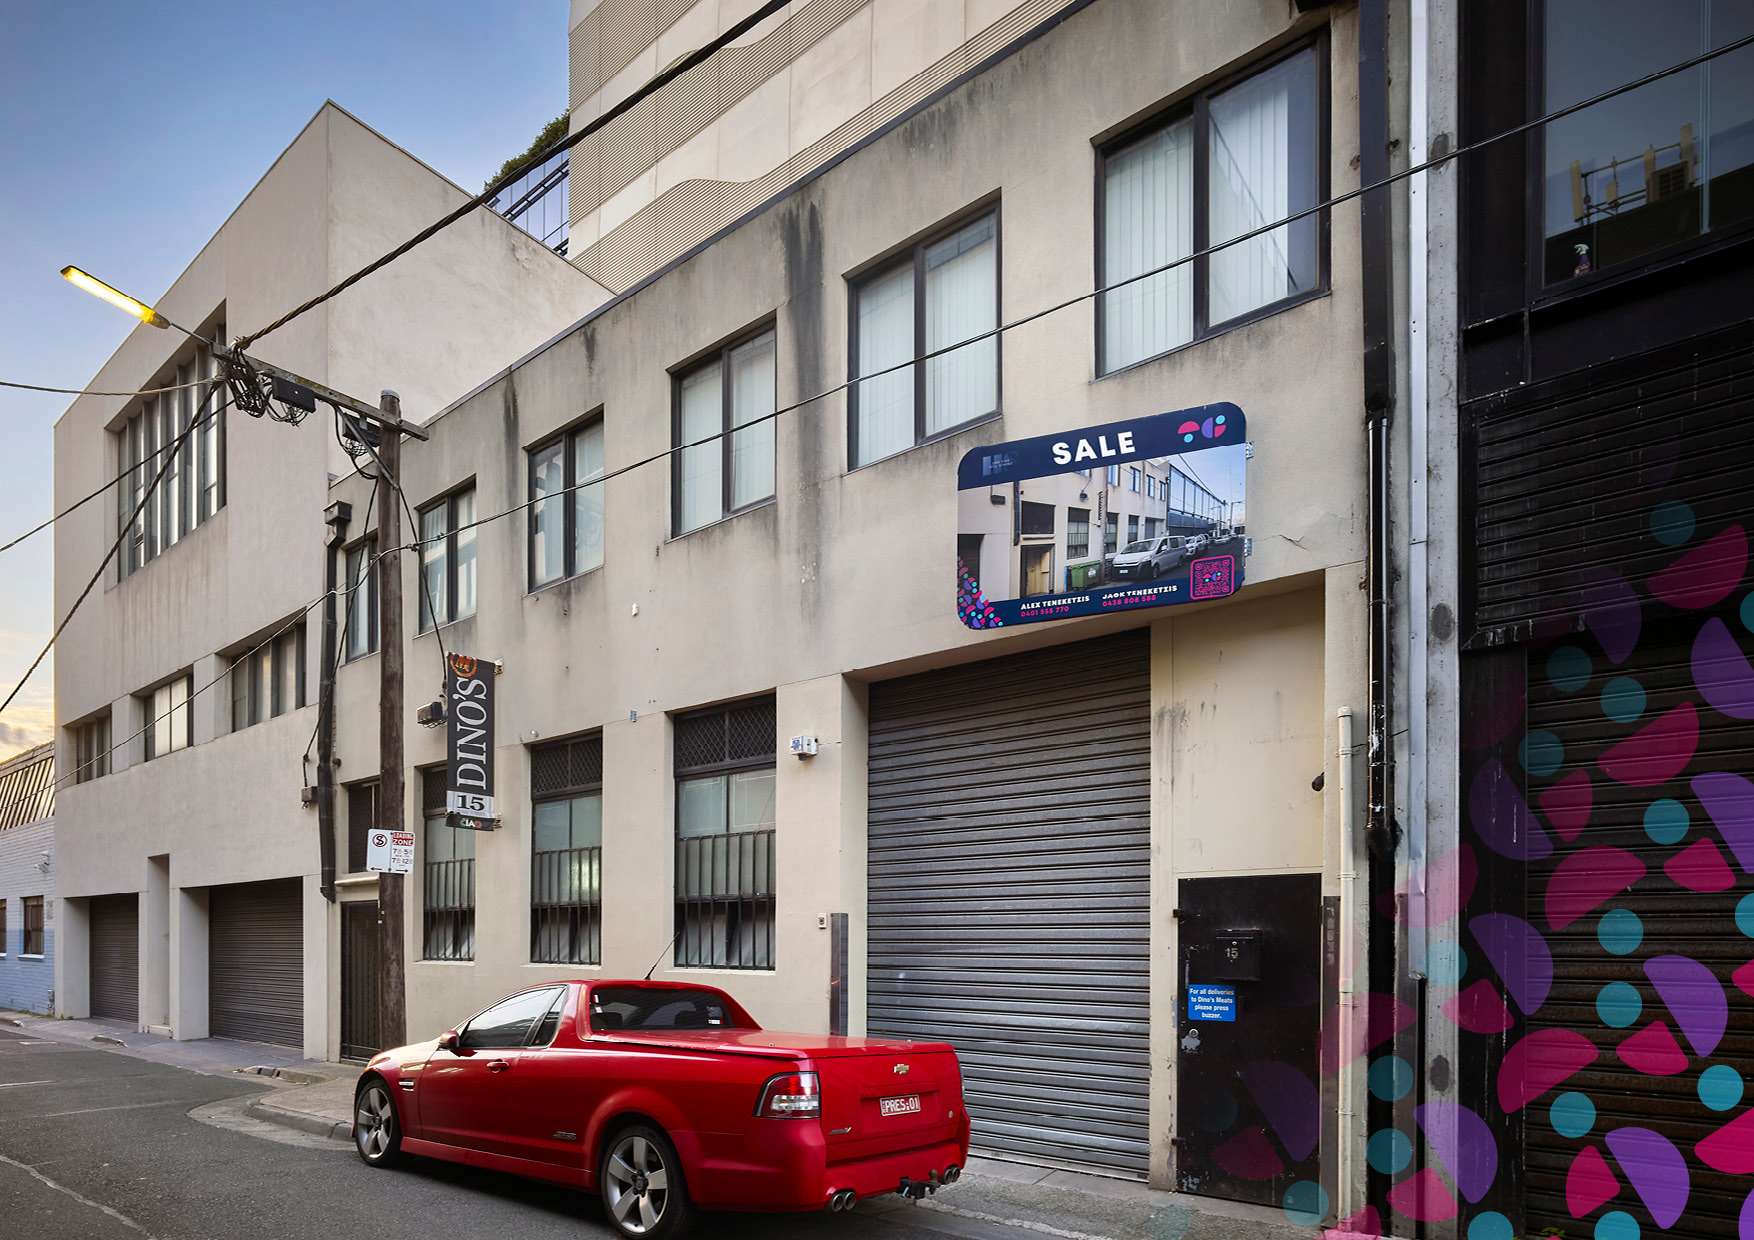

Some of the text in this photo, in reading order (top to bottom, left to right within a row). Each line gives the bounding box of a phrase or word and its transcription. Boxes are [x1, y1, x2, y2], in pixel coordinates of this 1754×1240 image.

[1052, 431, 1136, 465] SALE
[1126, 585, 1177, 596] TENEKETZIS
[1020, 595, 1090, 610] ALEX TENEKETZIS
[1102, 599, 1122, 607] 0438
[1020, 605, 1070, 618] 0401 555 770
[452, 677, 488, 790] DINO'S
[457, 794, 485, 811] 15
[1225, 947, 1239, 959] 15
[1194, 1003, 1212, 1011] please
